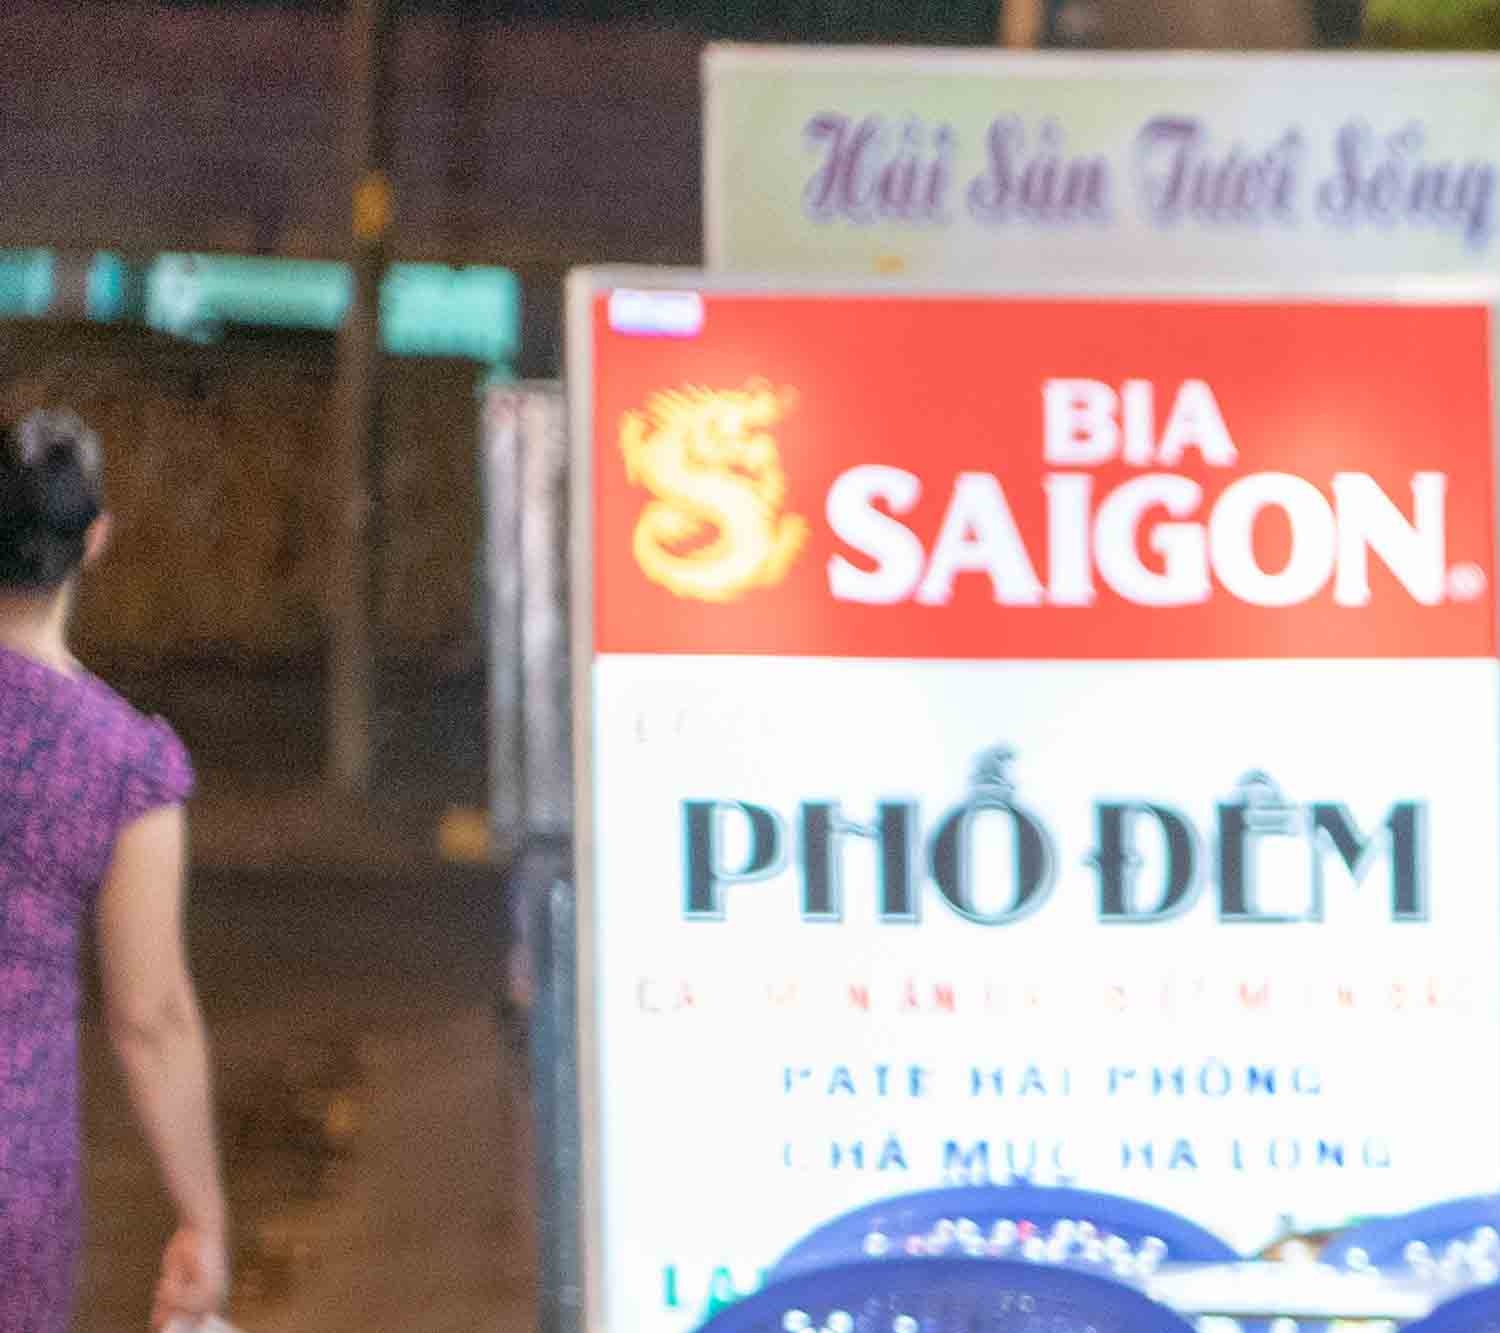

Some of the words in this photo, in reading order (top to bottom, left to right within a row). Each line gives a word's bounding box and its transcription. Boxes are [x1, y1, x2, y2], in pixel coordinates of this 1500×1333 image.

[1041, 377, 1238, 469] BIA
[824, 464, 1449, 608] SAIGON
[680, 742, 1057, 926] PHỐ
[1083, 768, 1432, 925] ĐÊM
